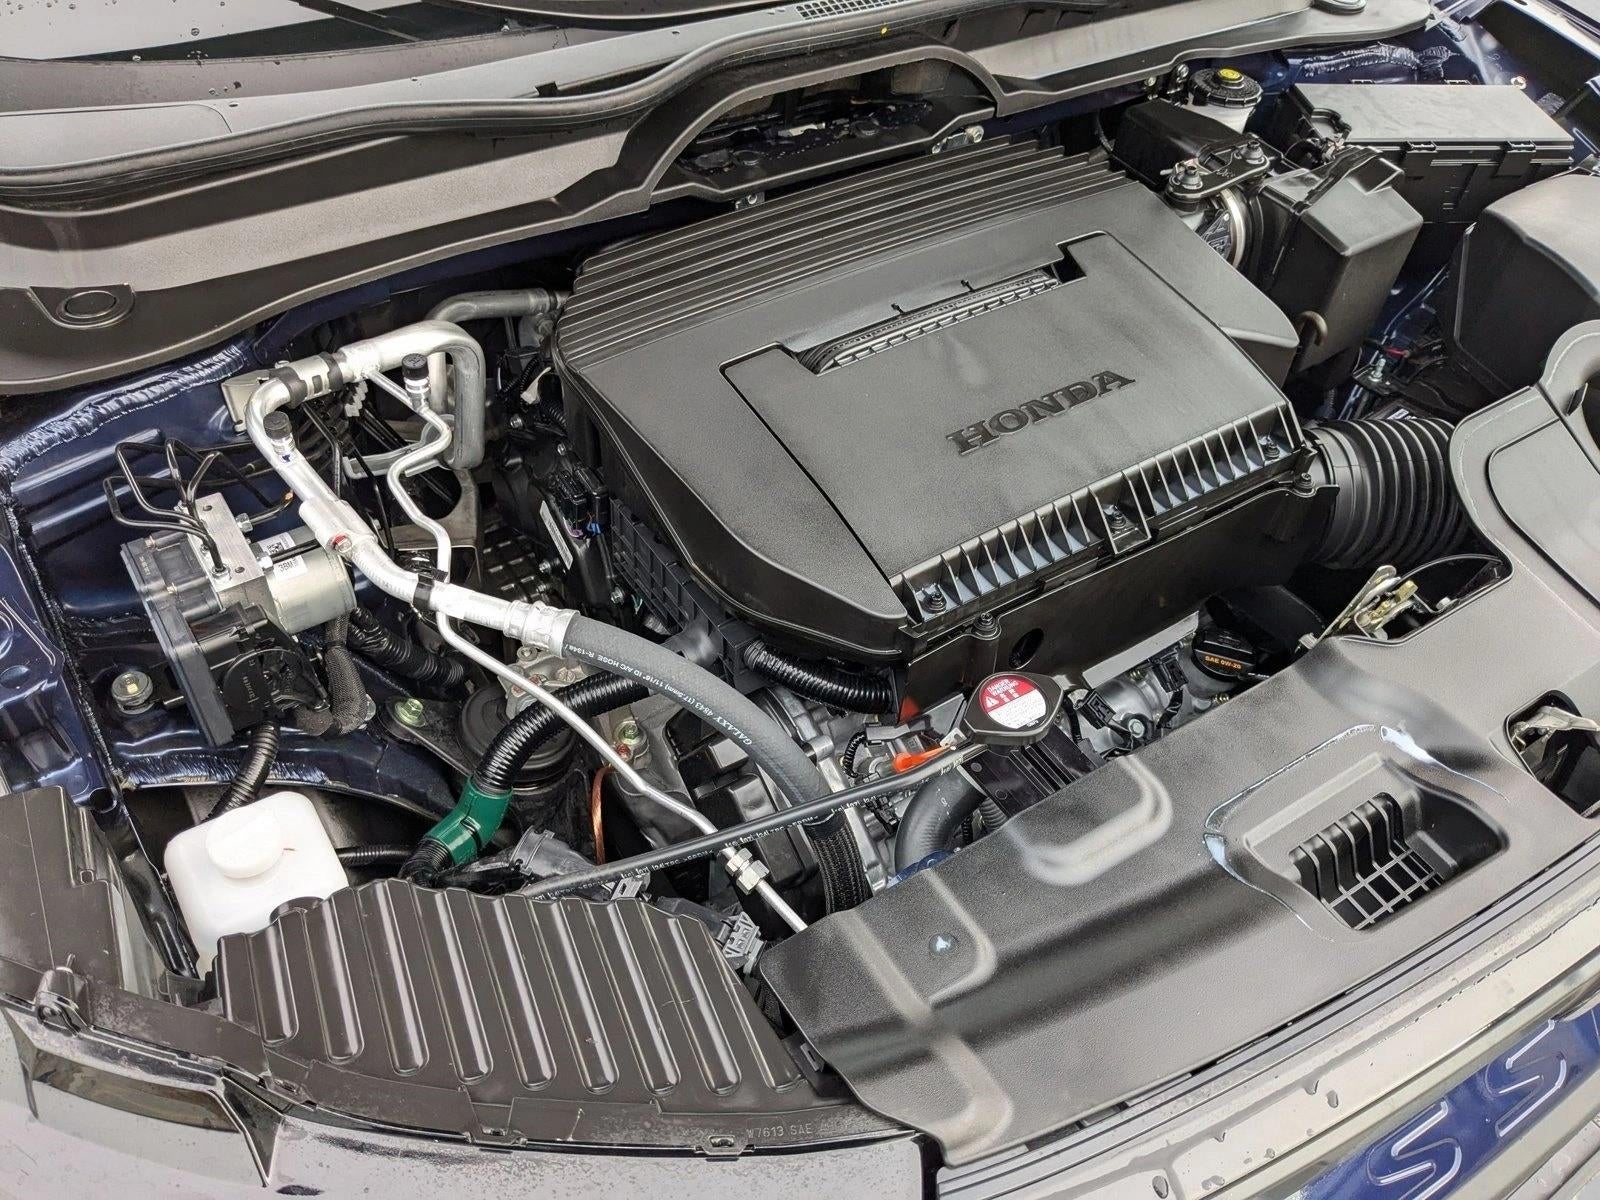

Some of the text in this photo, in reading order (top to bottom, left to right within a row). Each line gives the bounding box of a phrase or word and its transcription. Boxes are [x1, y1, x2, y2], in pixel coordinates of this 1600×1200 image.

[945, 370, 1136, 456] HONDA
[597, 654, 619, 667] HOSE
[1205, 655, 1242, 670] SAE 0W-20
[695, 702, 714, 717] 4843
[713, 716, 752, 745] GALAXY
[790, 1122, 814, 1136] SAE
